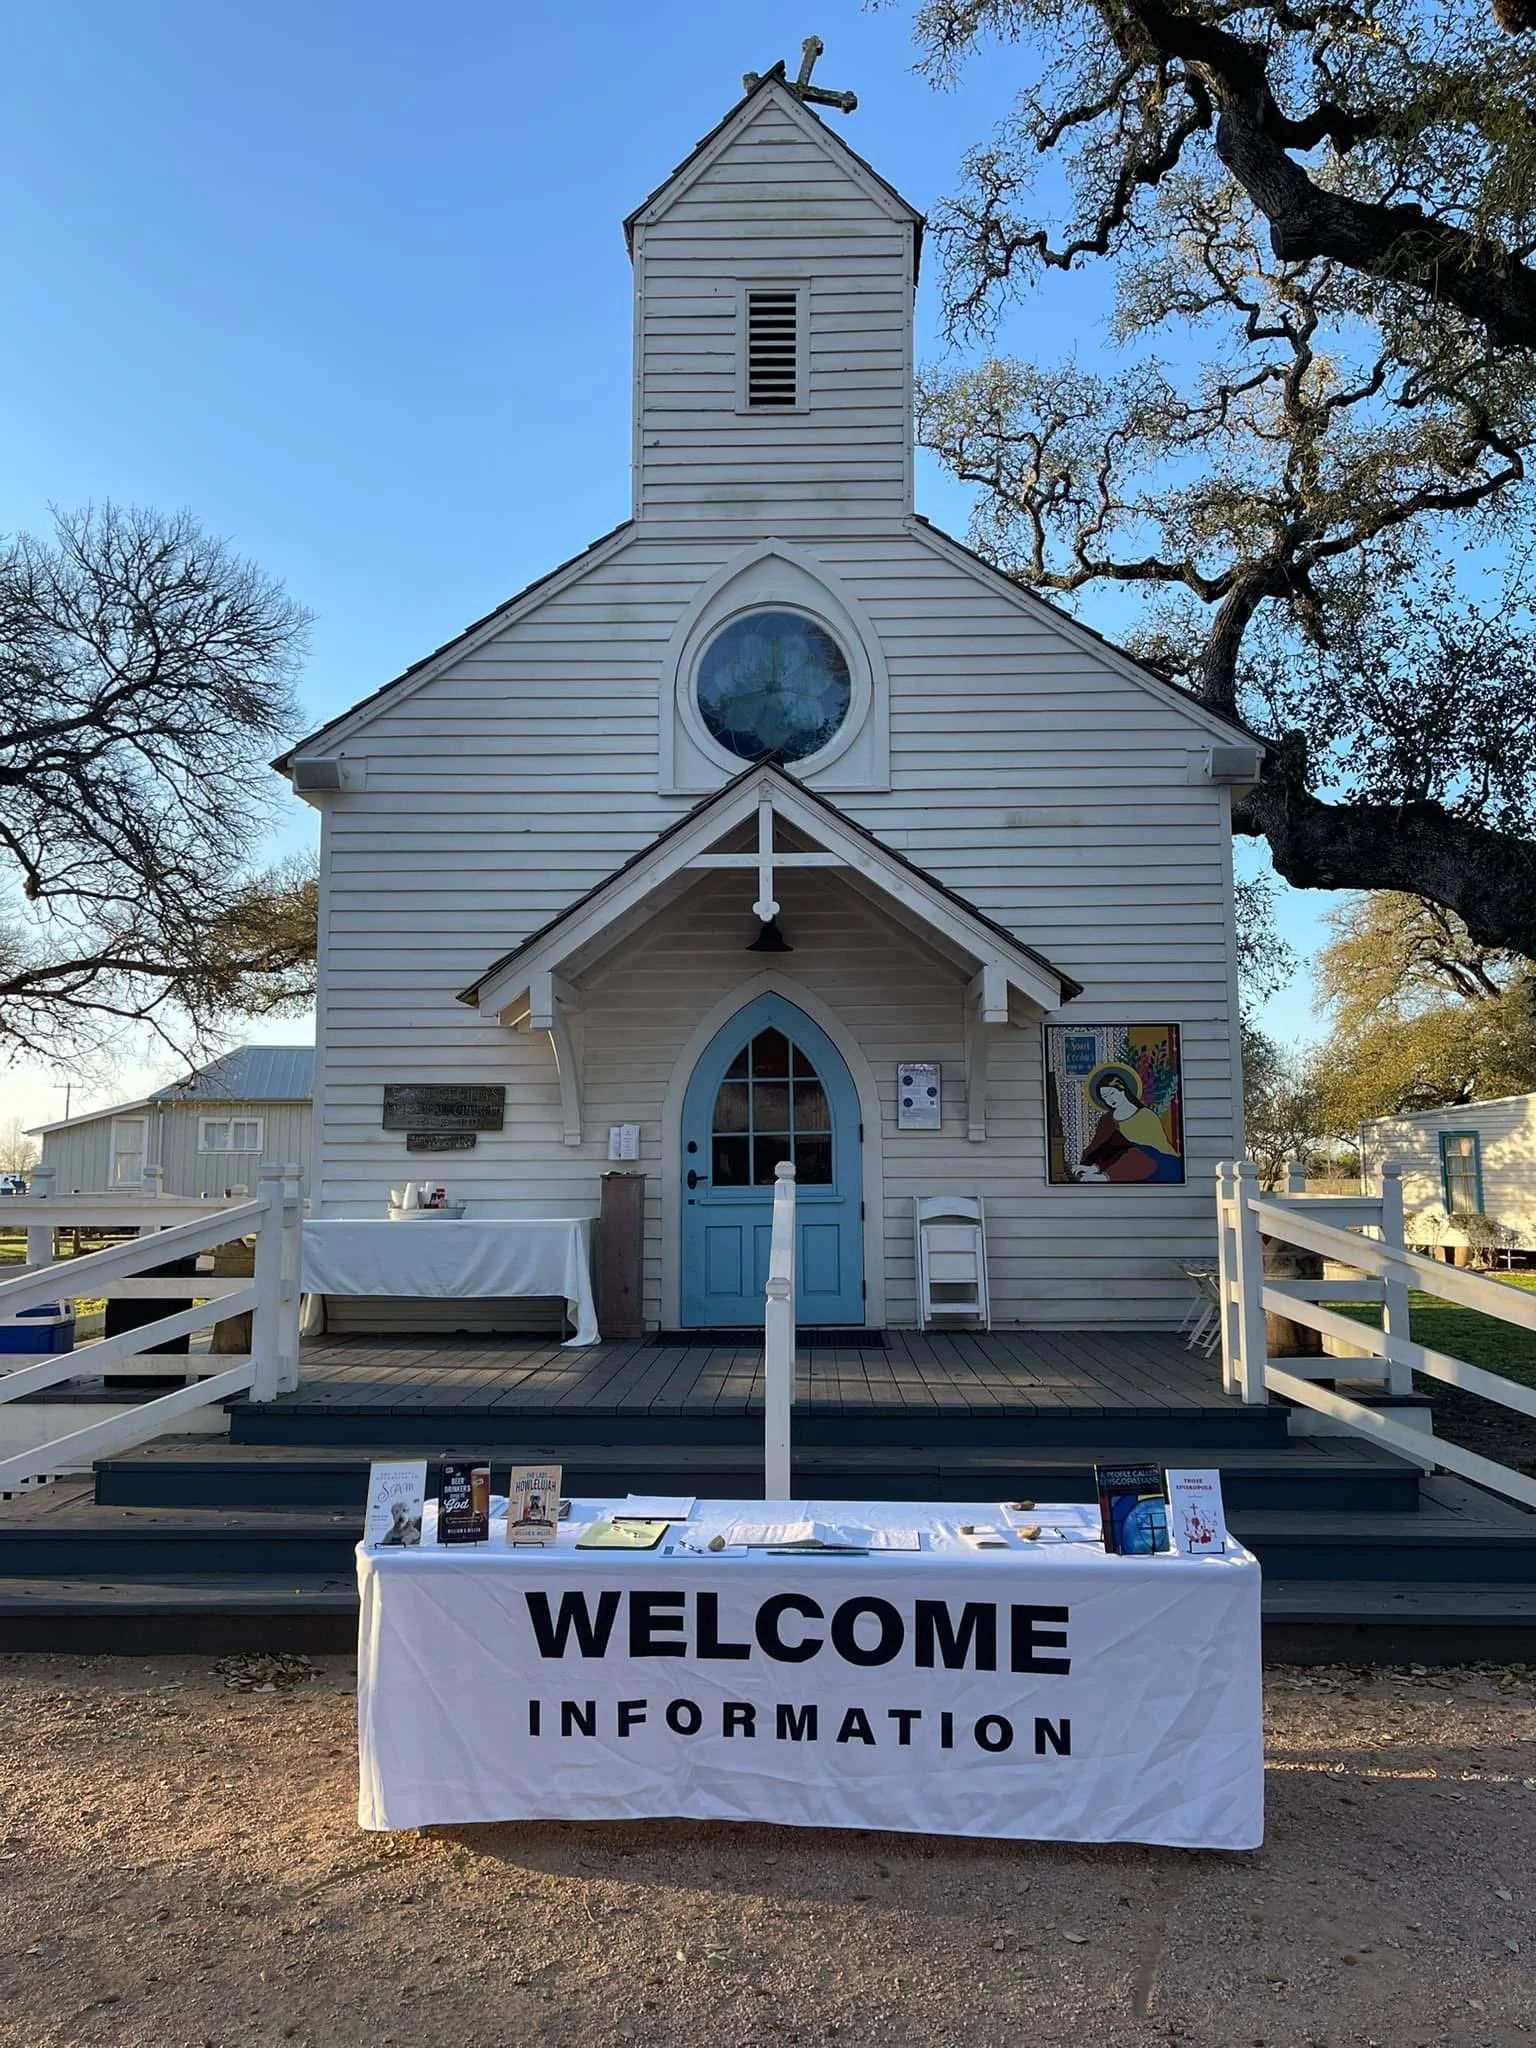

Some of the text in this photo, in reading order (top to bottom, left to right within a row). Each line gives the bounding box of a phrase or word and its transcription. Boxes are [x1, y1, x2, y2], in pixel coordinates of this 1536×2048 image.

[451, 1477, 465, 1486] BEER
[443, 1498, 470, 1513] God
[525, 1591, 1070, 1675] WELCOME
[530, 1699, 1070, 1755] INFORMATION
